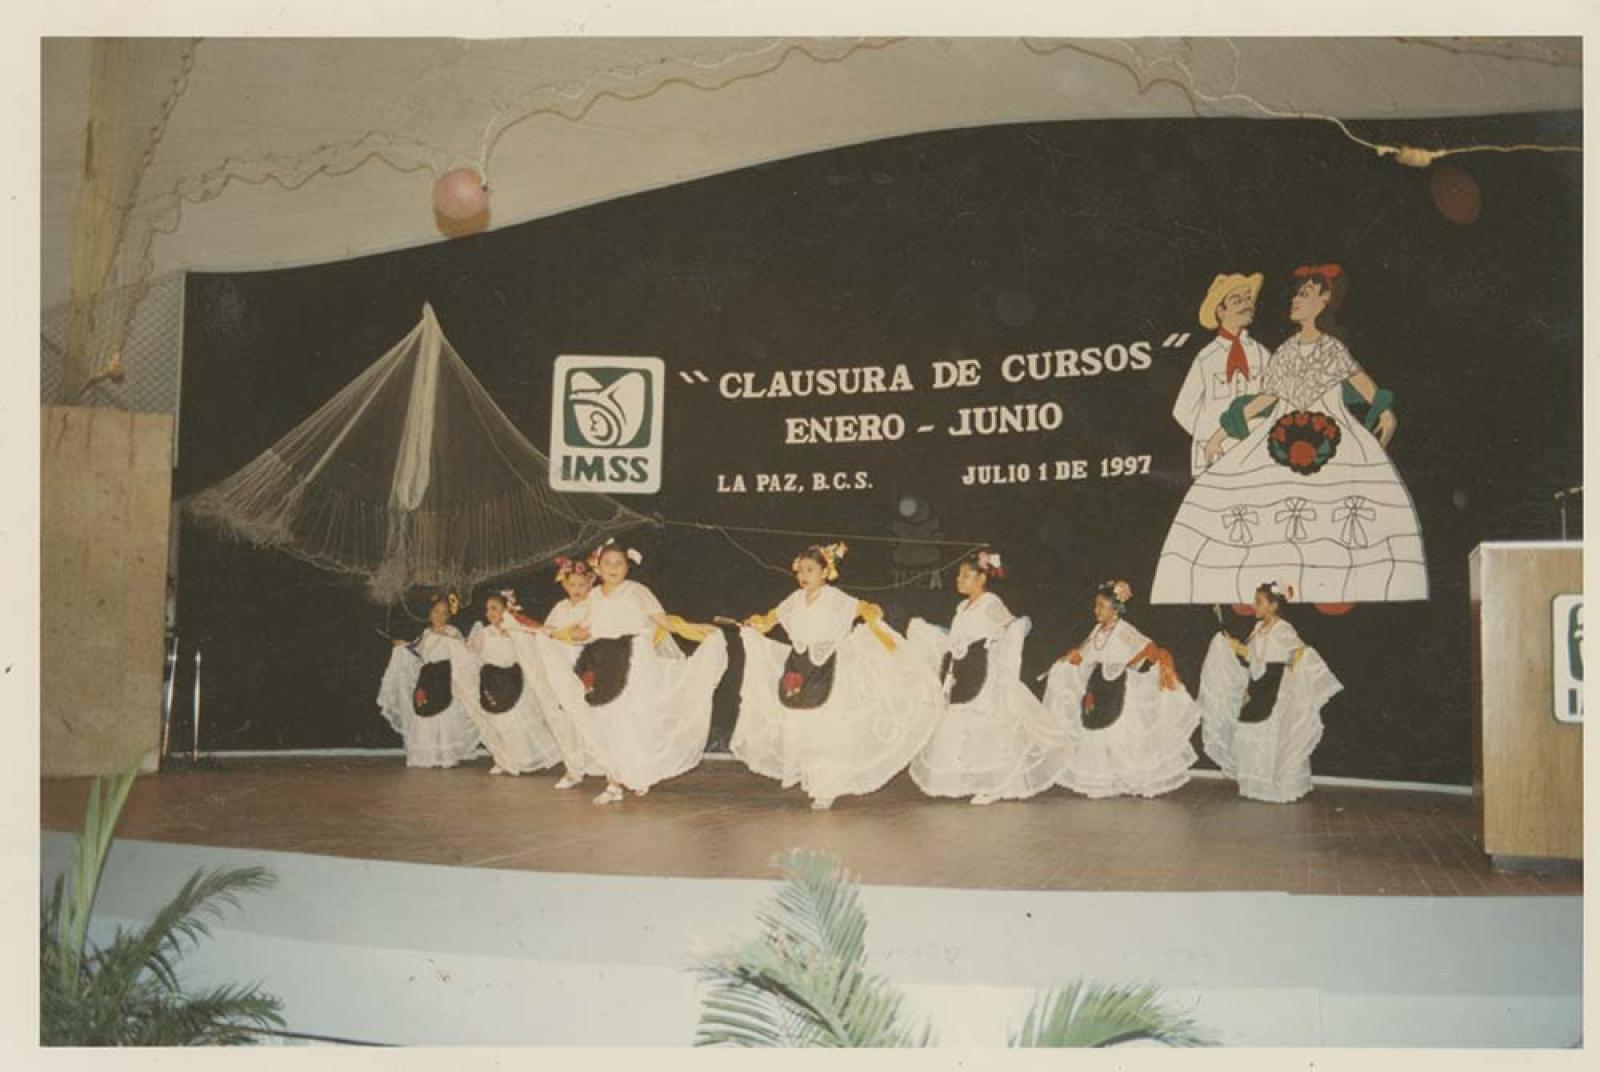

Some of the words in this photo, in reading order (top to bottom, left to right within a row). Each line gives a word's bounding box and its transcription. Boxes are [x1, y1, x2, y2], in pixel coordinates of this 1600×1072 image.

[932, 359, 982, 389] DE
[785, 413, 905, 444] ENERO
[948, 402, 1063, 436] JUNIO
[561, 455, 649, 483] IMSS
[717, 474, 747, 493] LA
[756, 473, 804, 494] PAZ,
[961, 463, 1030, 486] JULIO
[1038, 462, 1048, 481] 1
[1055, 460, 1088, 481] DE
[1100, 455, 1152, 478] 1997
